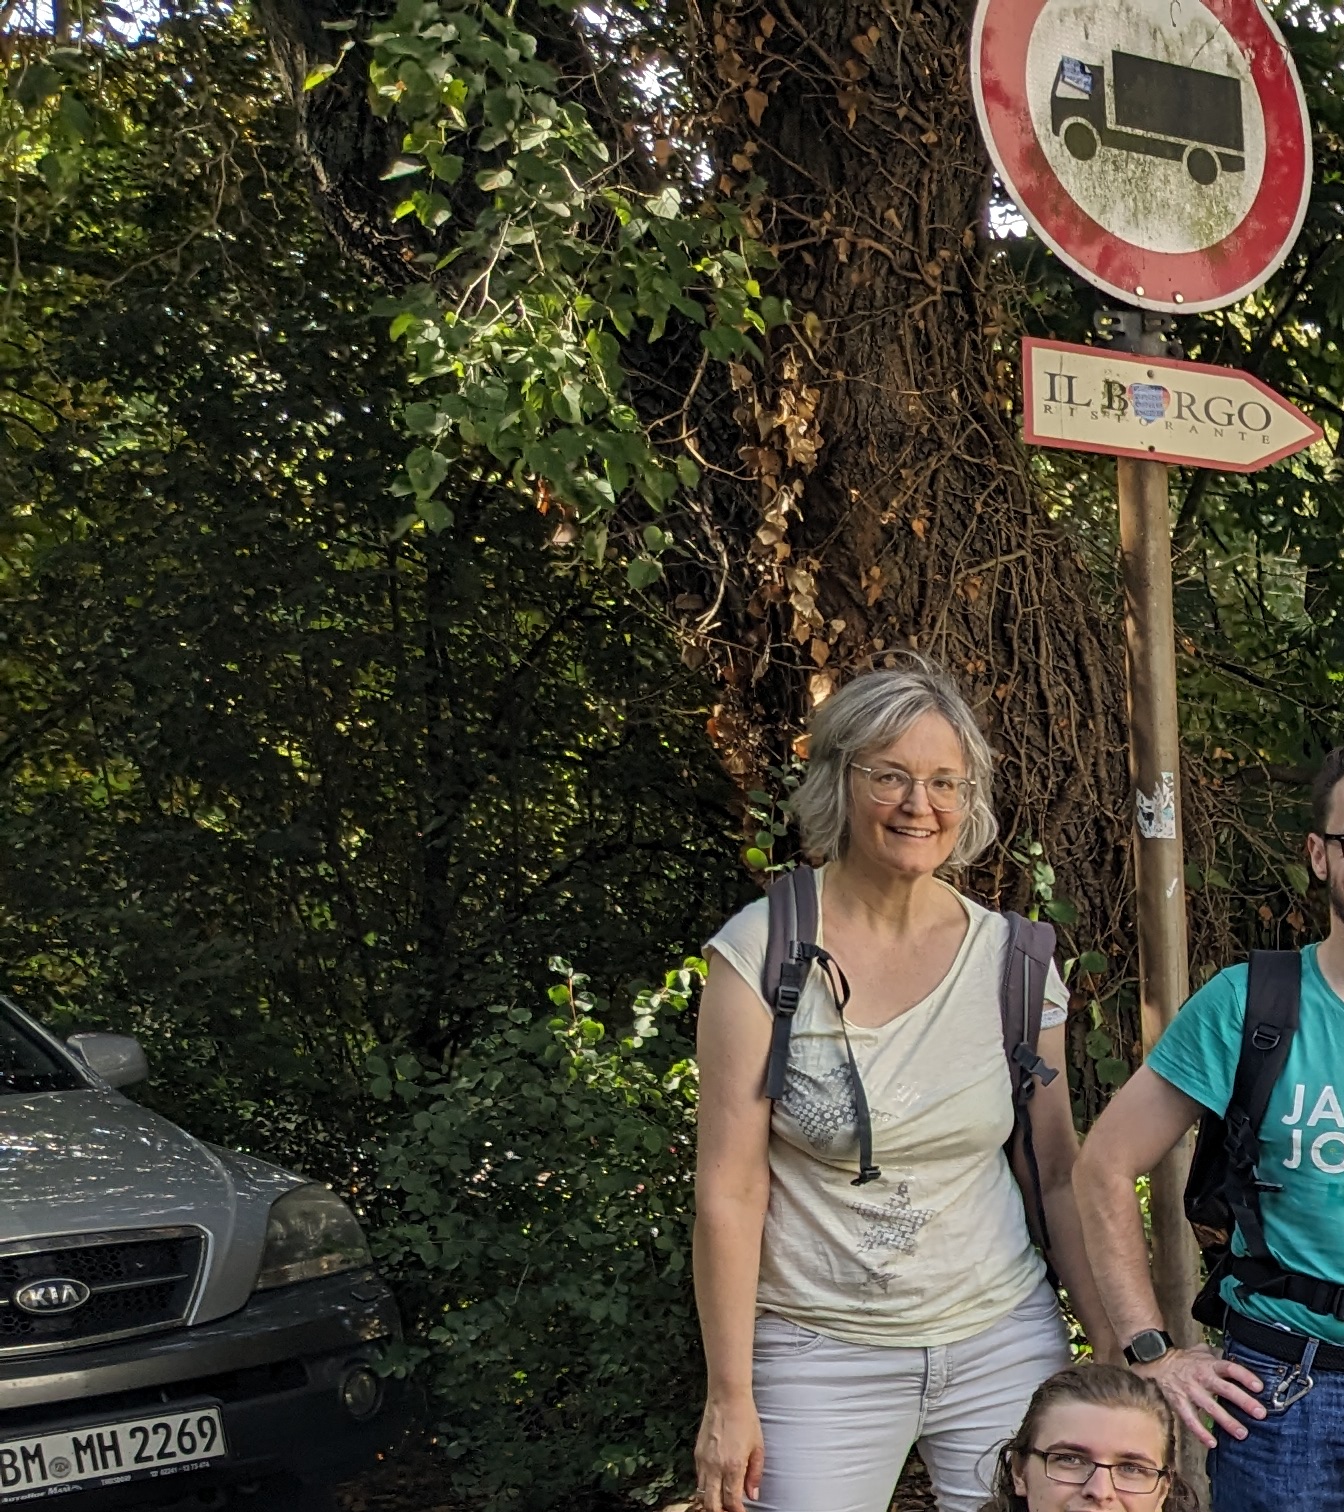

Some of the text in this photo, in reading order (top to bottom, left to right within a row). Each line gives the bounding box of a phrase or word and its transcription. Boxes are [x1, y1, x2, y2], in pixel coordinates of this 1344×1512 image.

[1044, 371, 1093, 407] IL
[1103, 379, 1273, 432] BRGO
[28, 1285, 80, 1307] KIA
[0, 1415, 218, 1488] BM MH 2269
